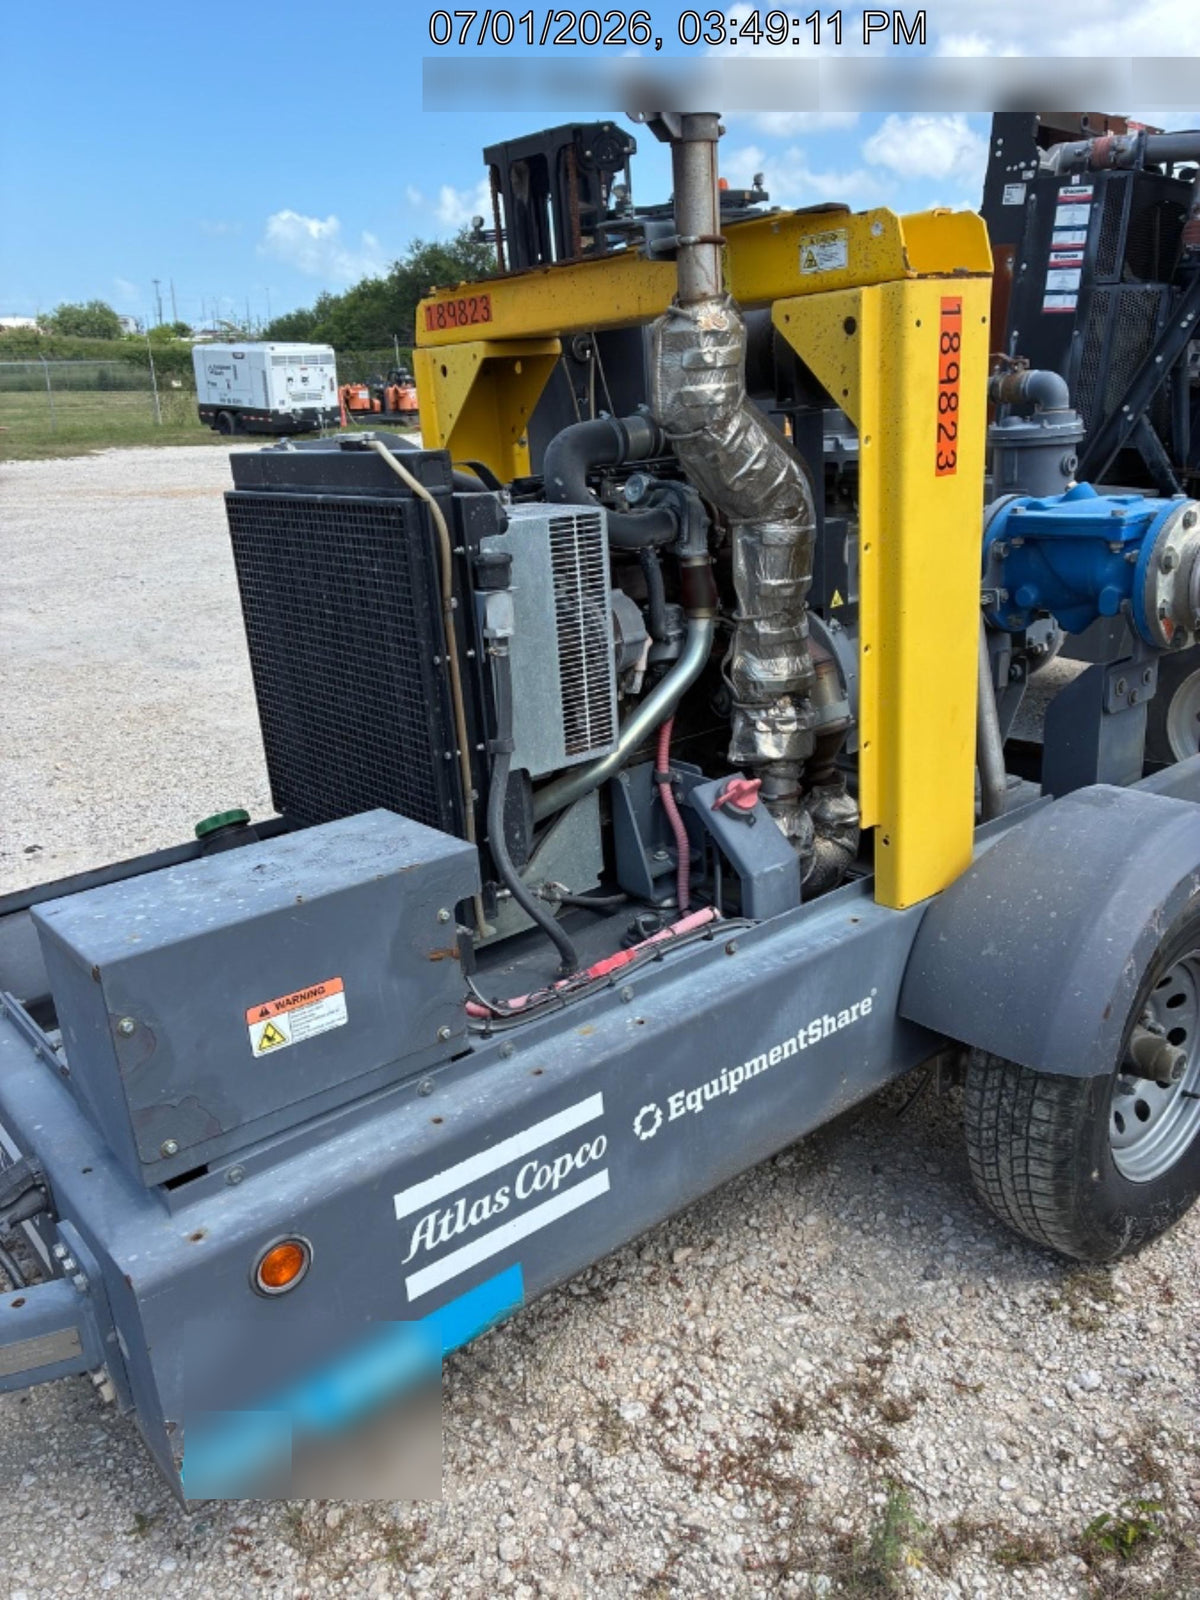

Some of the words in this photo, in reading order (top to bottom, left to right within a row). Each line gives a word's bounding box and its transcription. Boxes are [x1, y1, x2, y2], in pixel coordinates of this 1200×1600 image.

[426, 295, 490, 331] 189823
[936, 303, 962, 471] 189823
[274, 986, 326, 1011] WARNING
[401, 1185, 511, 1265] Atlas
[514, 1134, 608, 1200] Copco
